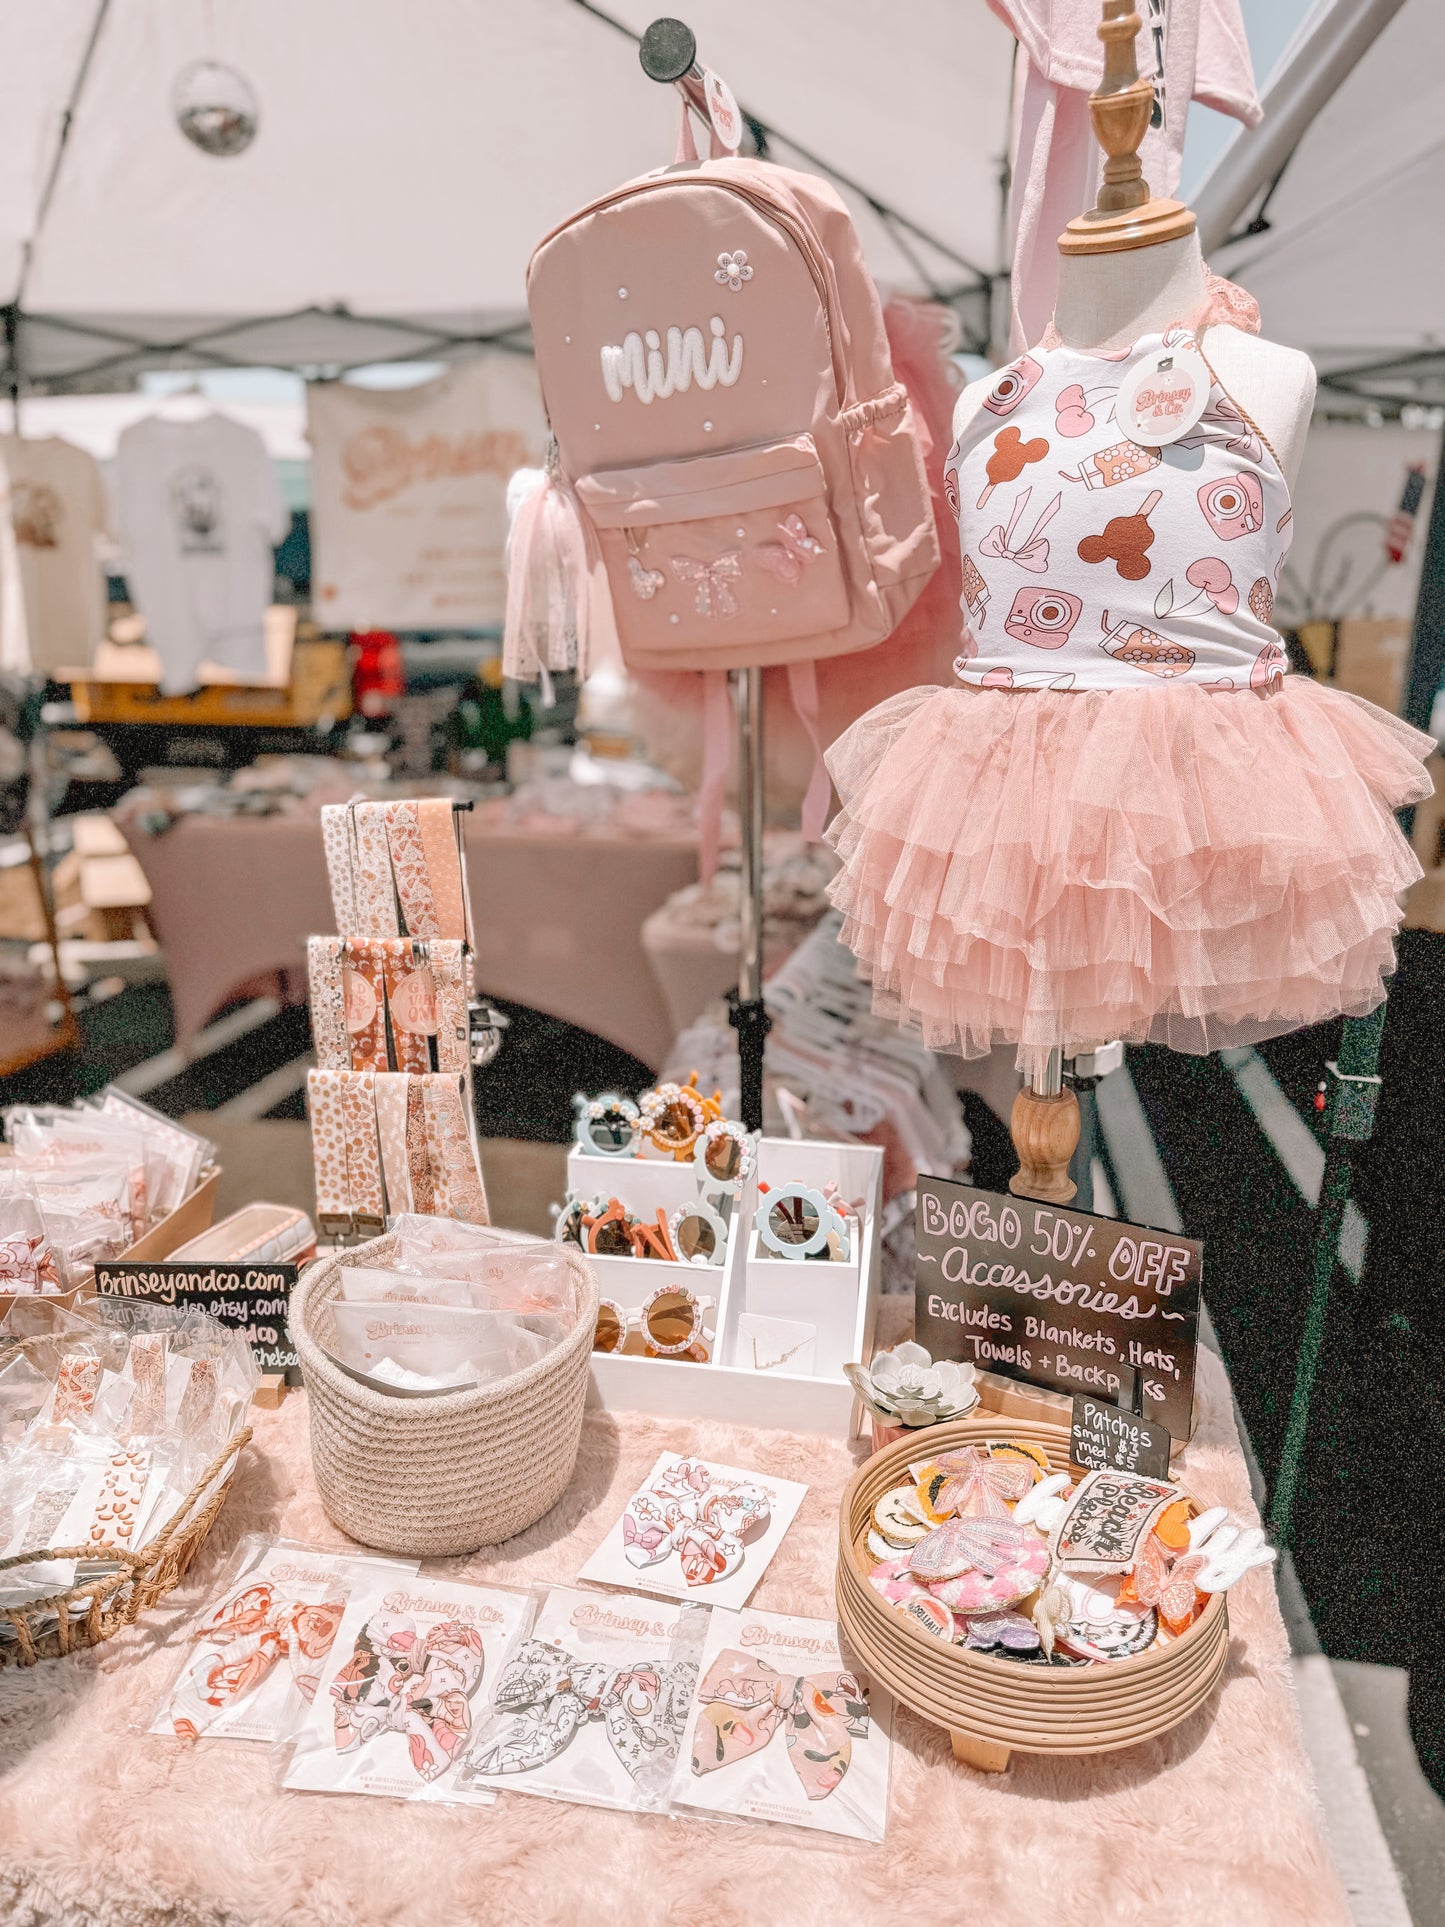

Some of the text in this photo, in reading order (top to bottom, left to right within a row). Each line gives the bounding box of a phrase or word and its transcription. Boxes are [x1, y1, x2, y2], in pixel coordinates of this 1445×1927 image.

[600, 315, 744, 405] mini
[1136, 387, 1192, 412] Brinsey
[1152, 404, 1163, 417] &
[921, 1193, 1190, 1296] BOGO 50% OFF
[928, 1295, 1012, 1331] Excludes
[1129, 1341, 1180, 1380] Hats,
[965, 1334, 1166, 1401] Towels + Backpks
[1084, 1403, 1153, 1448] Patches
[1115, 1452, 1137, 1469] $5
[1118, 1439, 1139, 1457] $3
[1067, 1482, 1121, 1544] Please
[1094, 1481, 1161, 1557] Beach
[380, 1590, 461, 1619] Brinsey
[462, 1606, 477, 1619] &
[569, 1603, 650, 1637] Brinsey
[650, 1621, 665, 1637] &
[739, 1624, 838, 1654] Brinsey &
[609, 1715, 627, 1736] 13
